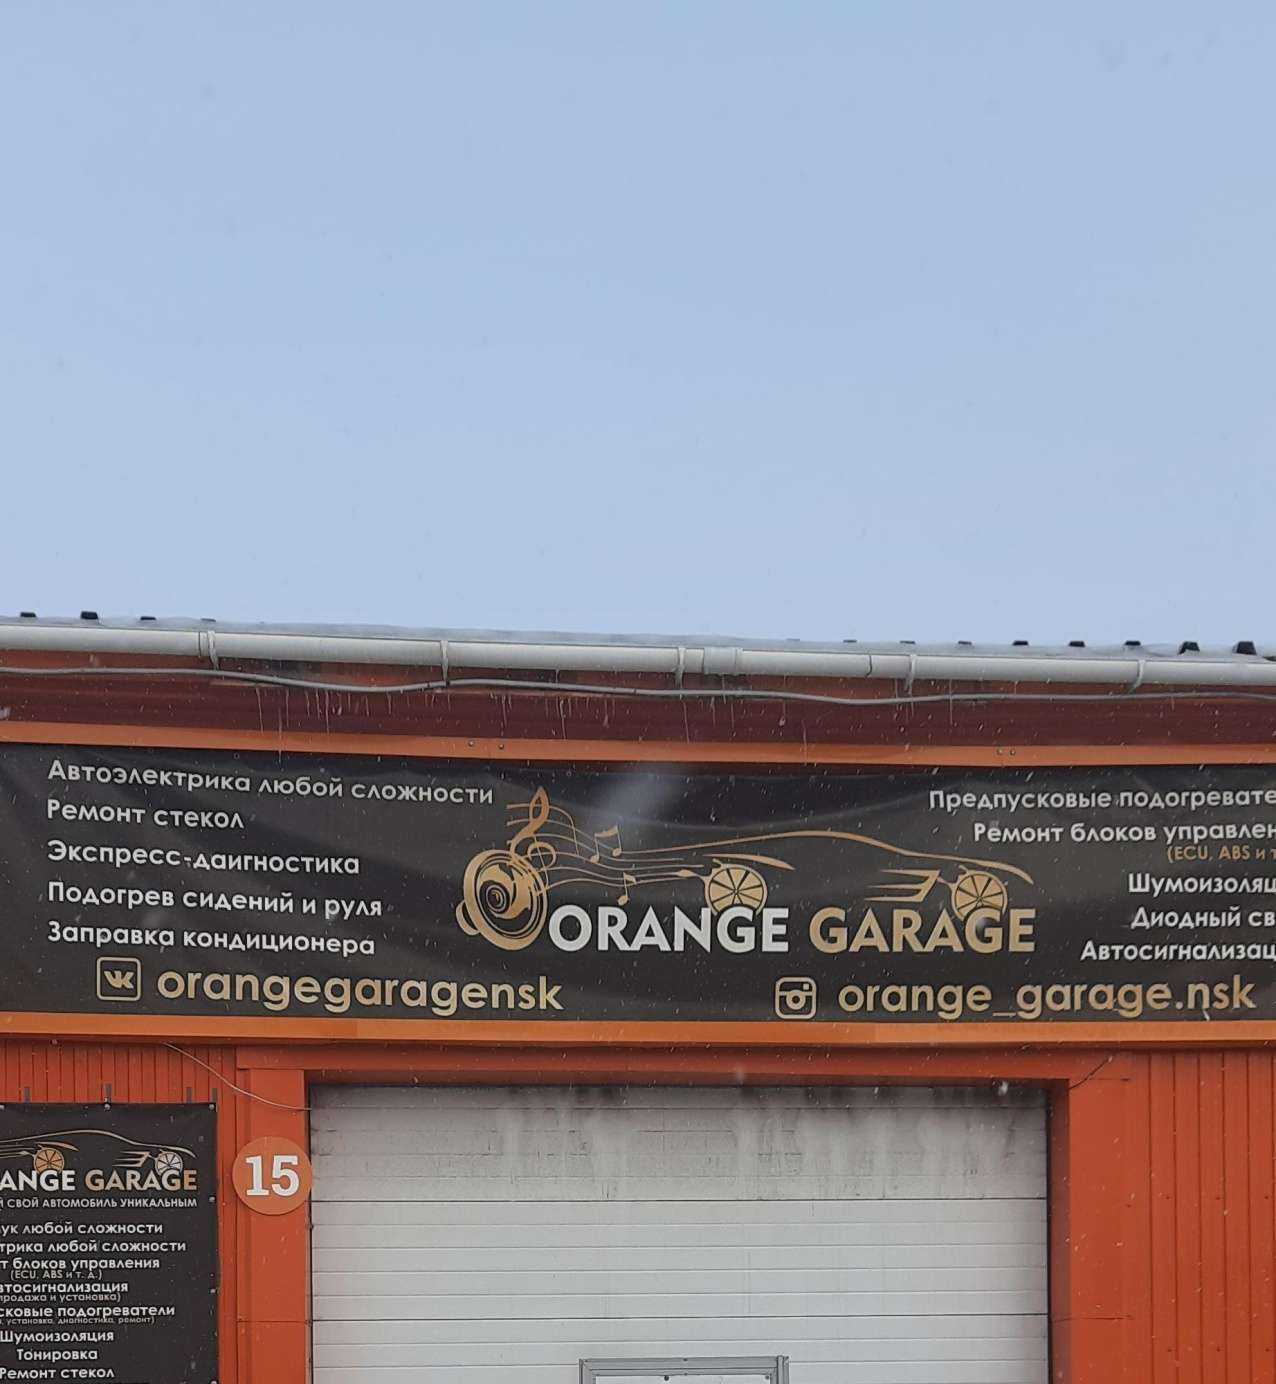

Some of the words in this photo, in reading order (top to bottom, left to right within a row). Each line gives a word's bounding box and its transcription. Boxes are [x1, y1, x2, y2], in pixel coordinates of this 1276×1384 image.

[48, 759, 251, 792] Автоэлектрика
[258, 776, 344, 798] любой
[351, 783, 494, 804] сложности
[929, 790, 1112, 812] Предпусковые
[1119, 789, 1276, 811] подогревате
[47, 800, 146, 825] Ремонт
[154, 807, 244, 830] стекол
[974, 823, 1064, 842] Ремонт
[1071, 823, 1157, 842] блоков
[1163, 823, 1276, 845] управлен
[47, 840, 361, 875] Экспресс-даигностика
[1219, 844, 1251, 860] ABS
[1255, 848, 1266, 860] и
[48, 881, 174, 909] Подогрев
[183, 890, 294, 913] сидений
[301, 897, 316, 914] и
[325, 898, 383, 921] руля
[1131, 904, 1241, 929] Диодный
[1248, 911, 1276, 927] св
[47, 921, 175, 947] Заправка
[183, 930, 375, 957] кондиционера
[548, 904, 790, 954] ORANGE
[808, 904, 1036, 954] GARAGE
[1081, 940, 1276, 962] Автосигнализац
[157, 969, 564, 1017] orangegaragensk
[837, 975, 1258, 1019] orange_garage.nsk
[85, 1169, 197, 1191] GARAGE
[246, 1154, 300, 1197] 15
[7, 1196, 39, 1208] СВОЙ
[42, 1198, 118, 1208] АВТОМОБИЛЬ
[120, 1198, 198, 1208] УНИКАЛЬНЫМ
[22, 1221, 73, 1234] любой
[78, 1224, 163, 1234] сложности
[48, 1240, 97, 1252] любой
[102, 1242, 186, 1252] сложности
[12, 1257, 66, 1270] блоков
[71, 1259, 160, 1271] управления
[43, 1269, 63, 1279] ABS
[66, 1271, 73, 1279] и
[50, 1294, 57, 1302] и
[57, 1306, 175, 1320] подогреватели
[0, 1330, 114, 1345] Шумоизоляция
[17, 1348, 98, 1362] Тонировка
[0, 1367, 56, 1379] Ремонт
[60, 1368, 115, 1379] стекол
